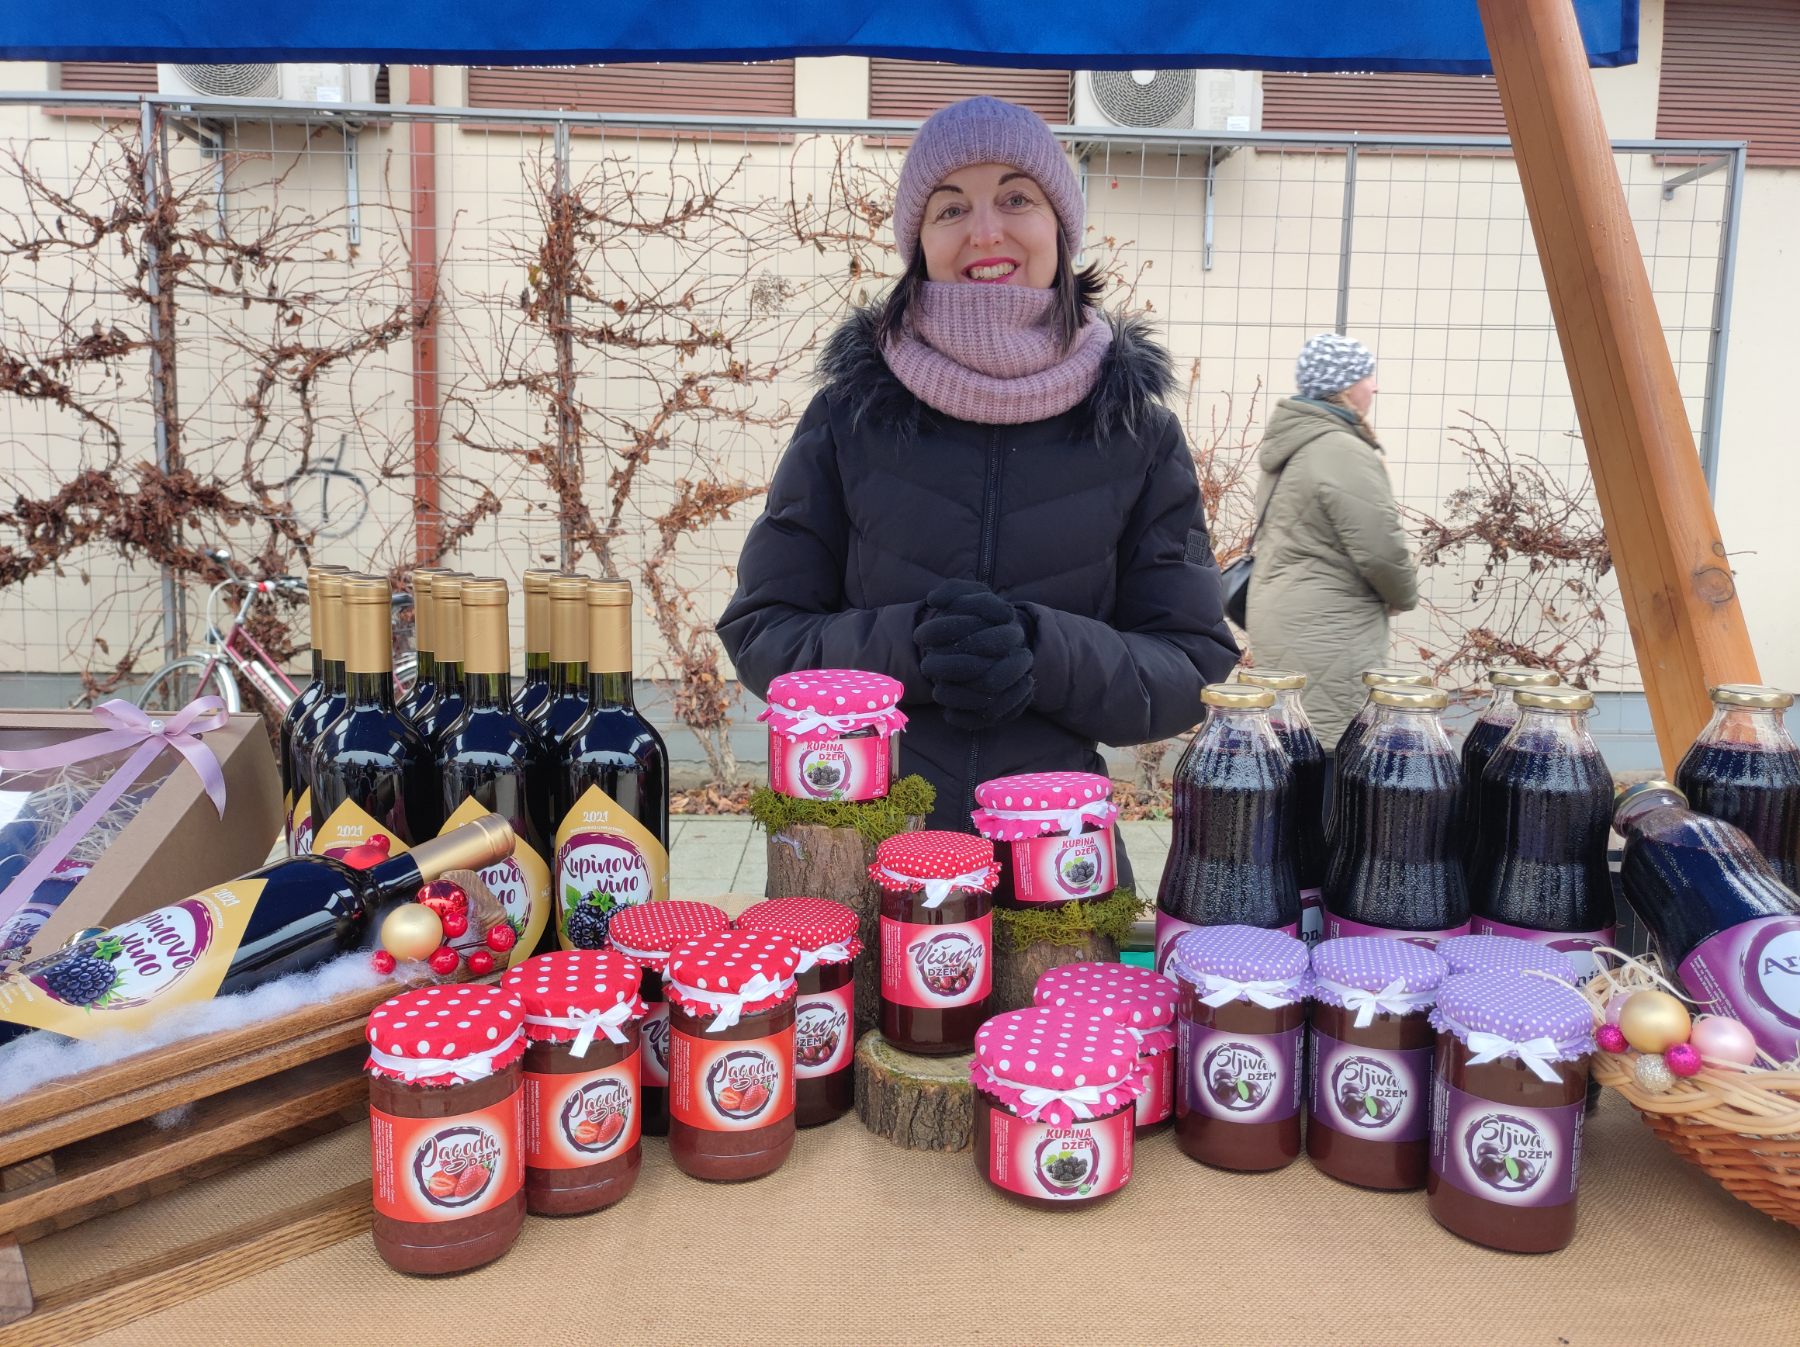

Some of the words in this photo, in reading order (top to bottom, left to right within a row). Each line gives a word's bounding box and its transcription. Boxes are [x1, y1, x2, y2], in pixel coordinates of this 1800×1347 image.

[806, 742, 844, 751] KUPINA
[818, 752, 845, 760] DŽEM
[583, 811, 608, 822] 2021
[337, 825, 363, 838] 2021
[1062, 837, 1095, 848] KUPINA
[558, 844, 643, 882] Kupinovo
[597, 875, 638, 894] vino
[120, 932, 162, 976] vino
[909, 942, 985, 967] Višnja
[927, 966, 958, 977] DŽEM
[797, 1036, 821, 1047] ŽEM
[1216, 1042, 1269, 1077] Šljiva
[714, 1055, 777, 1090] Jagoda
[753, 1072, 779, 1086] DŽEM
[1247, 1071, 1276, 1080] DŽEM
[1342, 1055, 1398, 1091] Šljiva
[1376, 1087, 1408, 1098] DŽEM
[568, 1082, 630, 1122] Jagoda
[609, 1096, 632, 1115] DŽEM
[1045, 1127, 1093, 1139] KUPINA
[1481, 1112, 1542, 1154] Šljiva
[1061, 1138, 1094, 1150] DŽEM
[421, 1130, 497, 1175] Jagoda
[468, 1147, 501, 1167] DŽEM
[1517, 1147, 1553, 1160] DŽEM
